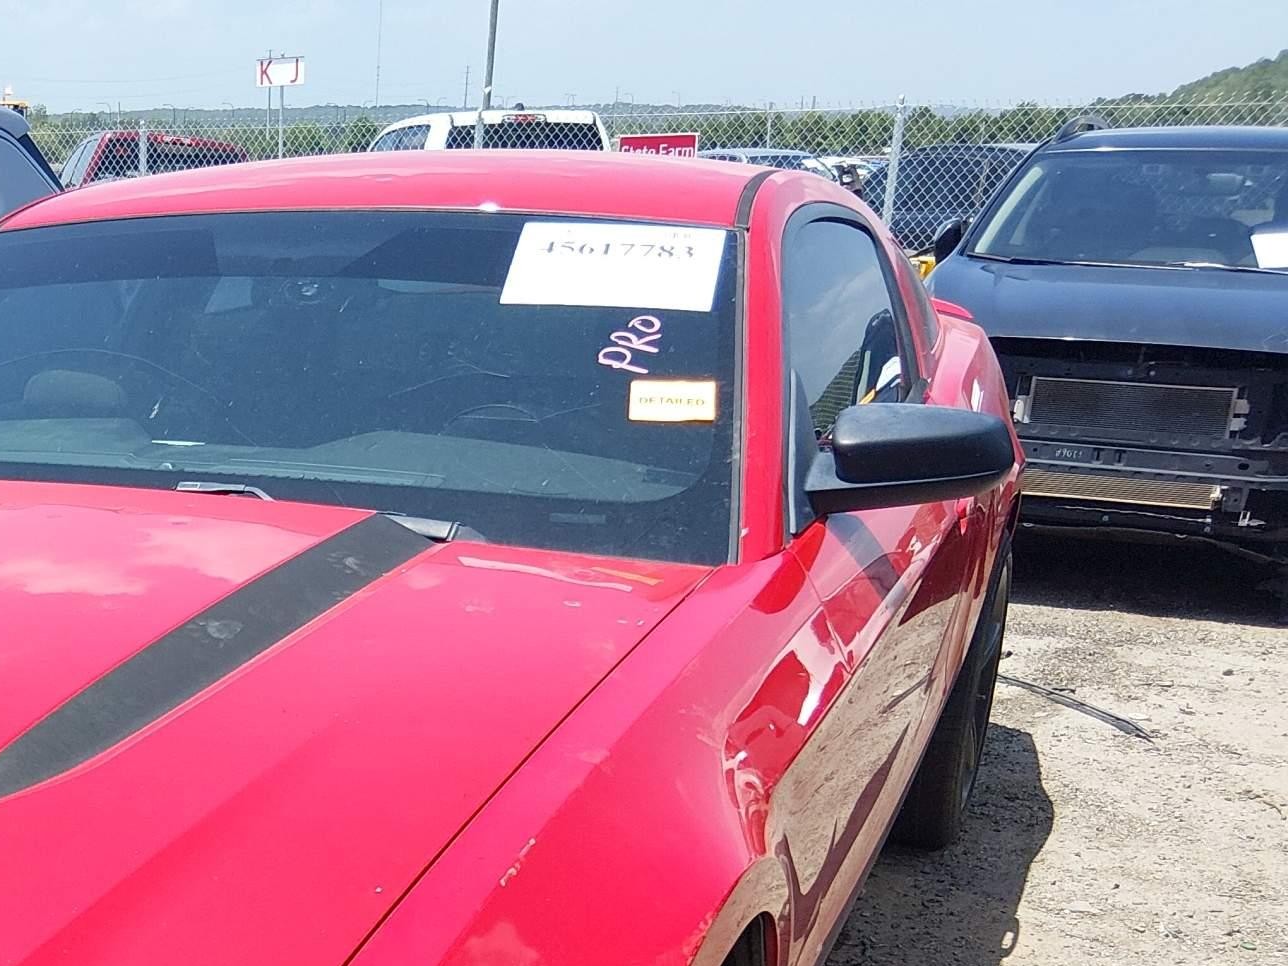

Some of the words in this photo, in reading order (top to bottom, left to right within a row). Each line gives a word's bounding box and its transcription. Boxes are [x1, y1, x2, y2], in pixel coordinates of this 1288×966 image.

[260, 60, 273, 85] K
[289, 58, 300, 83] J
[658, 143, 695, 158] Farm
[537, 240, 695, 259] 45617783
[638, 396, 705, 407] DETAILED
